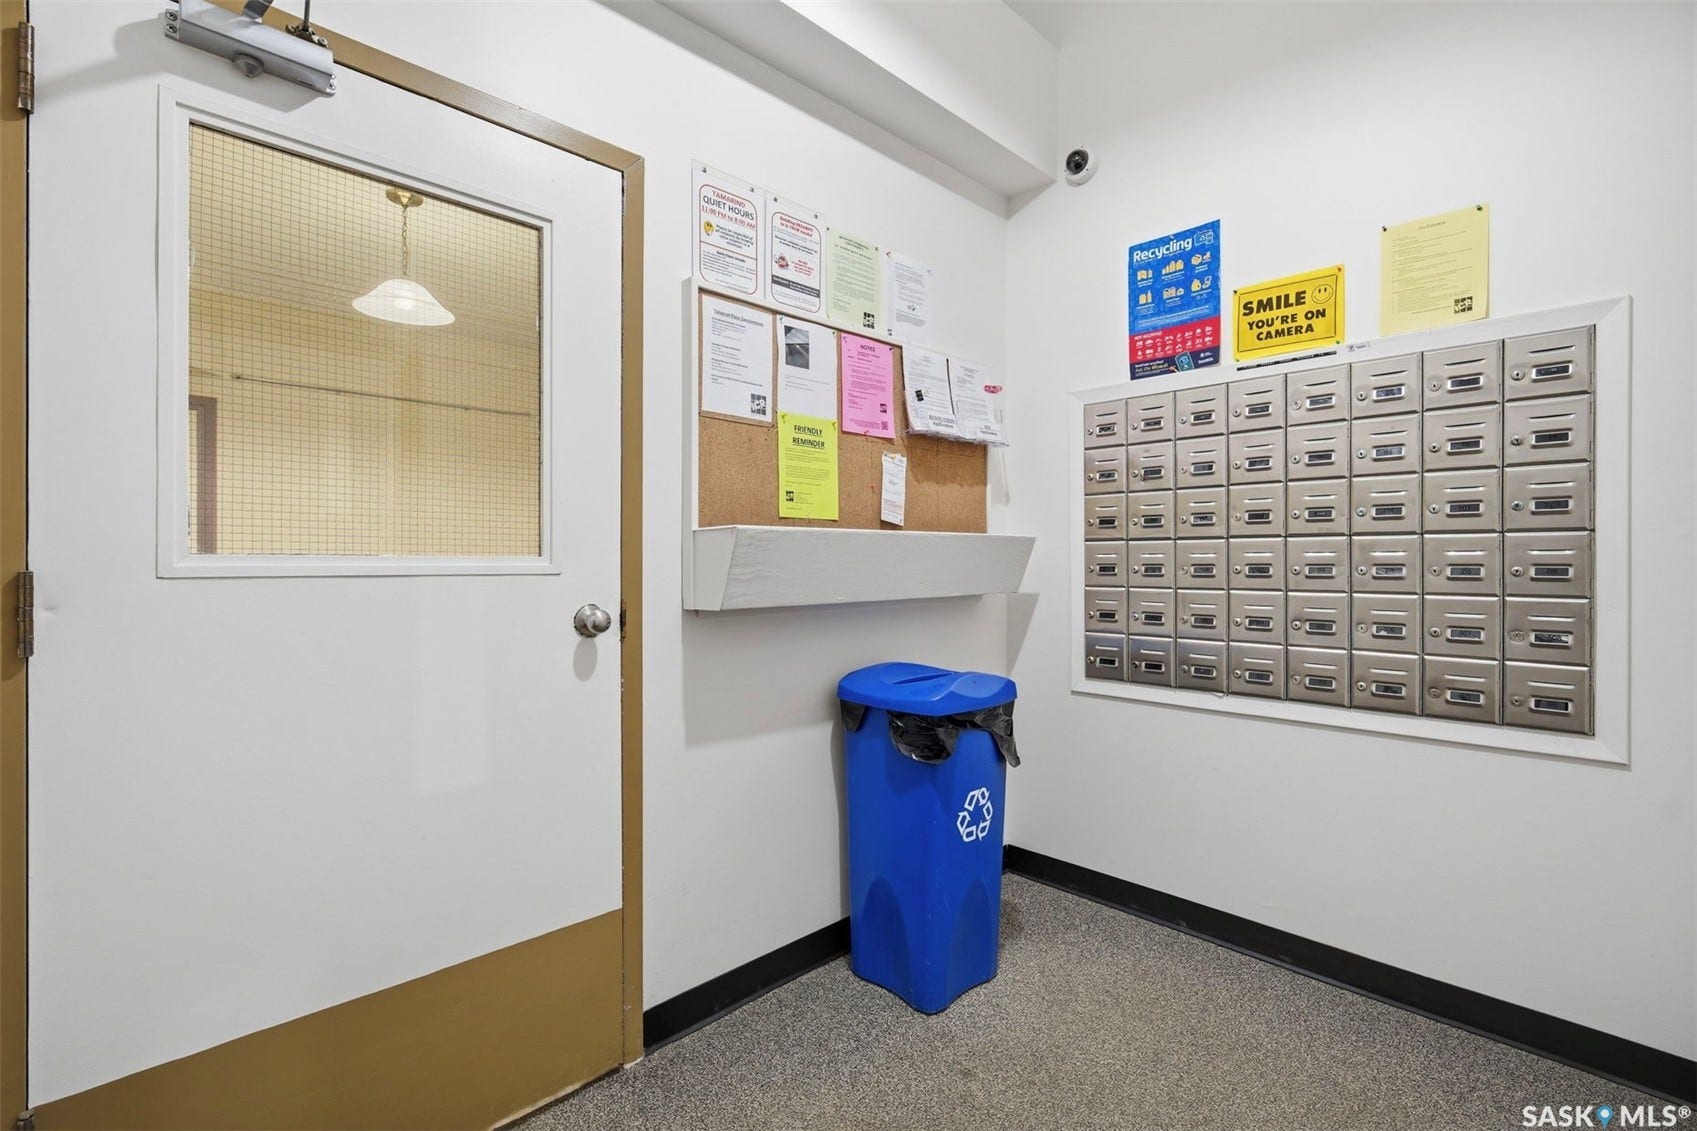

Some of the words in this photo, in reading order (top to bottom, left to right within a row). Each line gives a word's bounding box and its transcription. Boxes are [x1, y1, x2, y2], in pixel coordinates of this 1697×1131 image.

[703, 195, 727, 210] QUIET
[728, 204, 754, 221] HOURS
[1133, 238, 1193, 263] Recycling
[1242, 290, 1307, 317] SMILE
[1247, 313, 1298, 331] YOU'RE
[1304, 308, 1327, 321] ON
[1256, 323, 1315, 341] CAMERA
[860, 344, 876, 352] NOTICE
[794, 424, 823, 435] FRIENDLY
[792, 436, 825, 448] REMINDER
